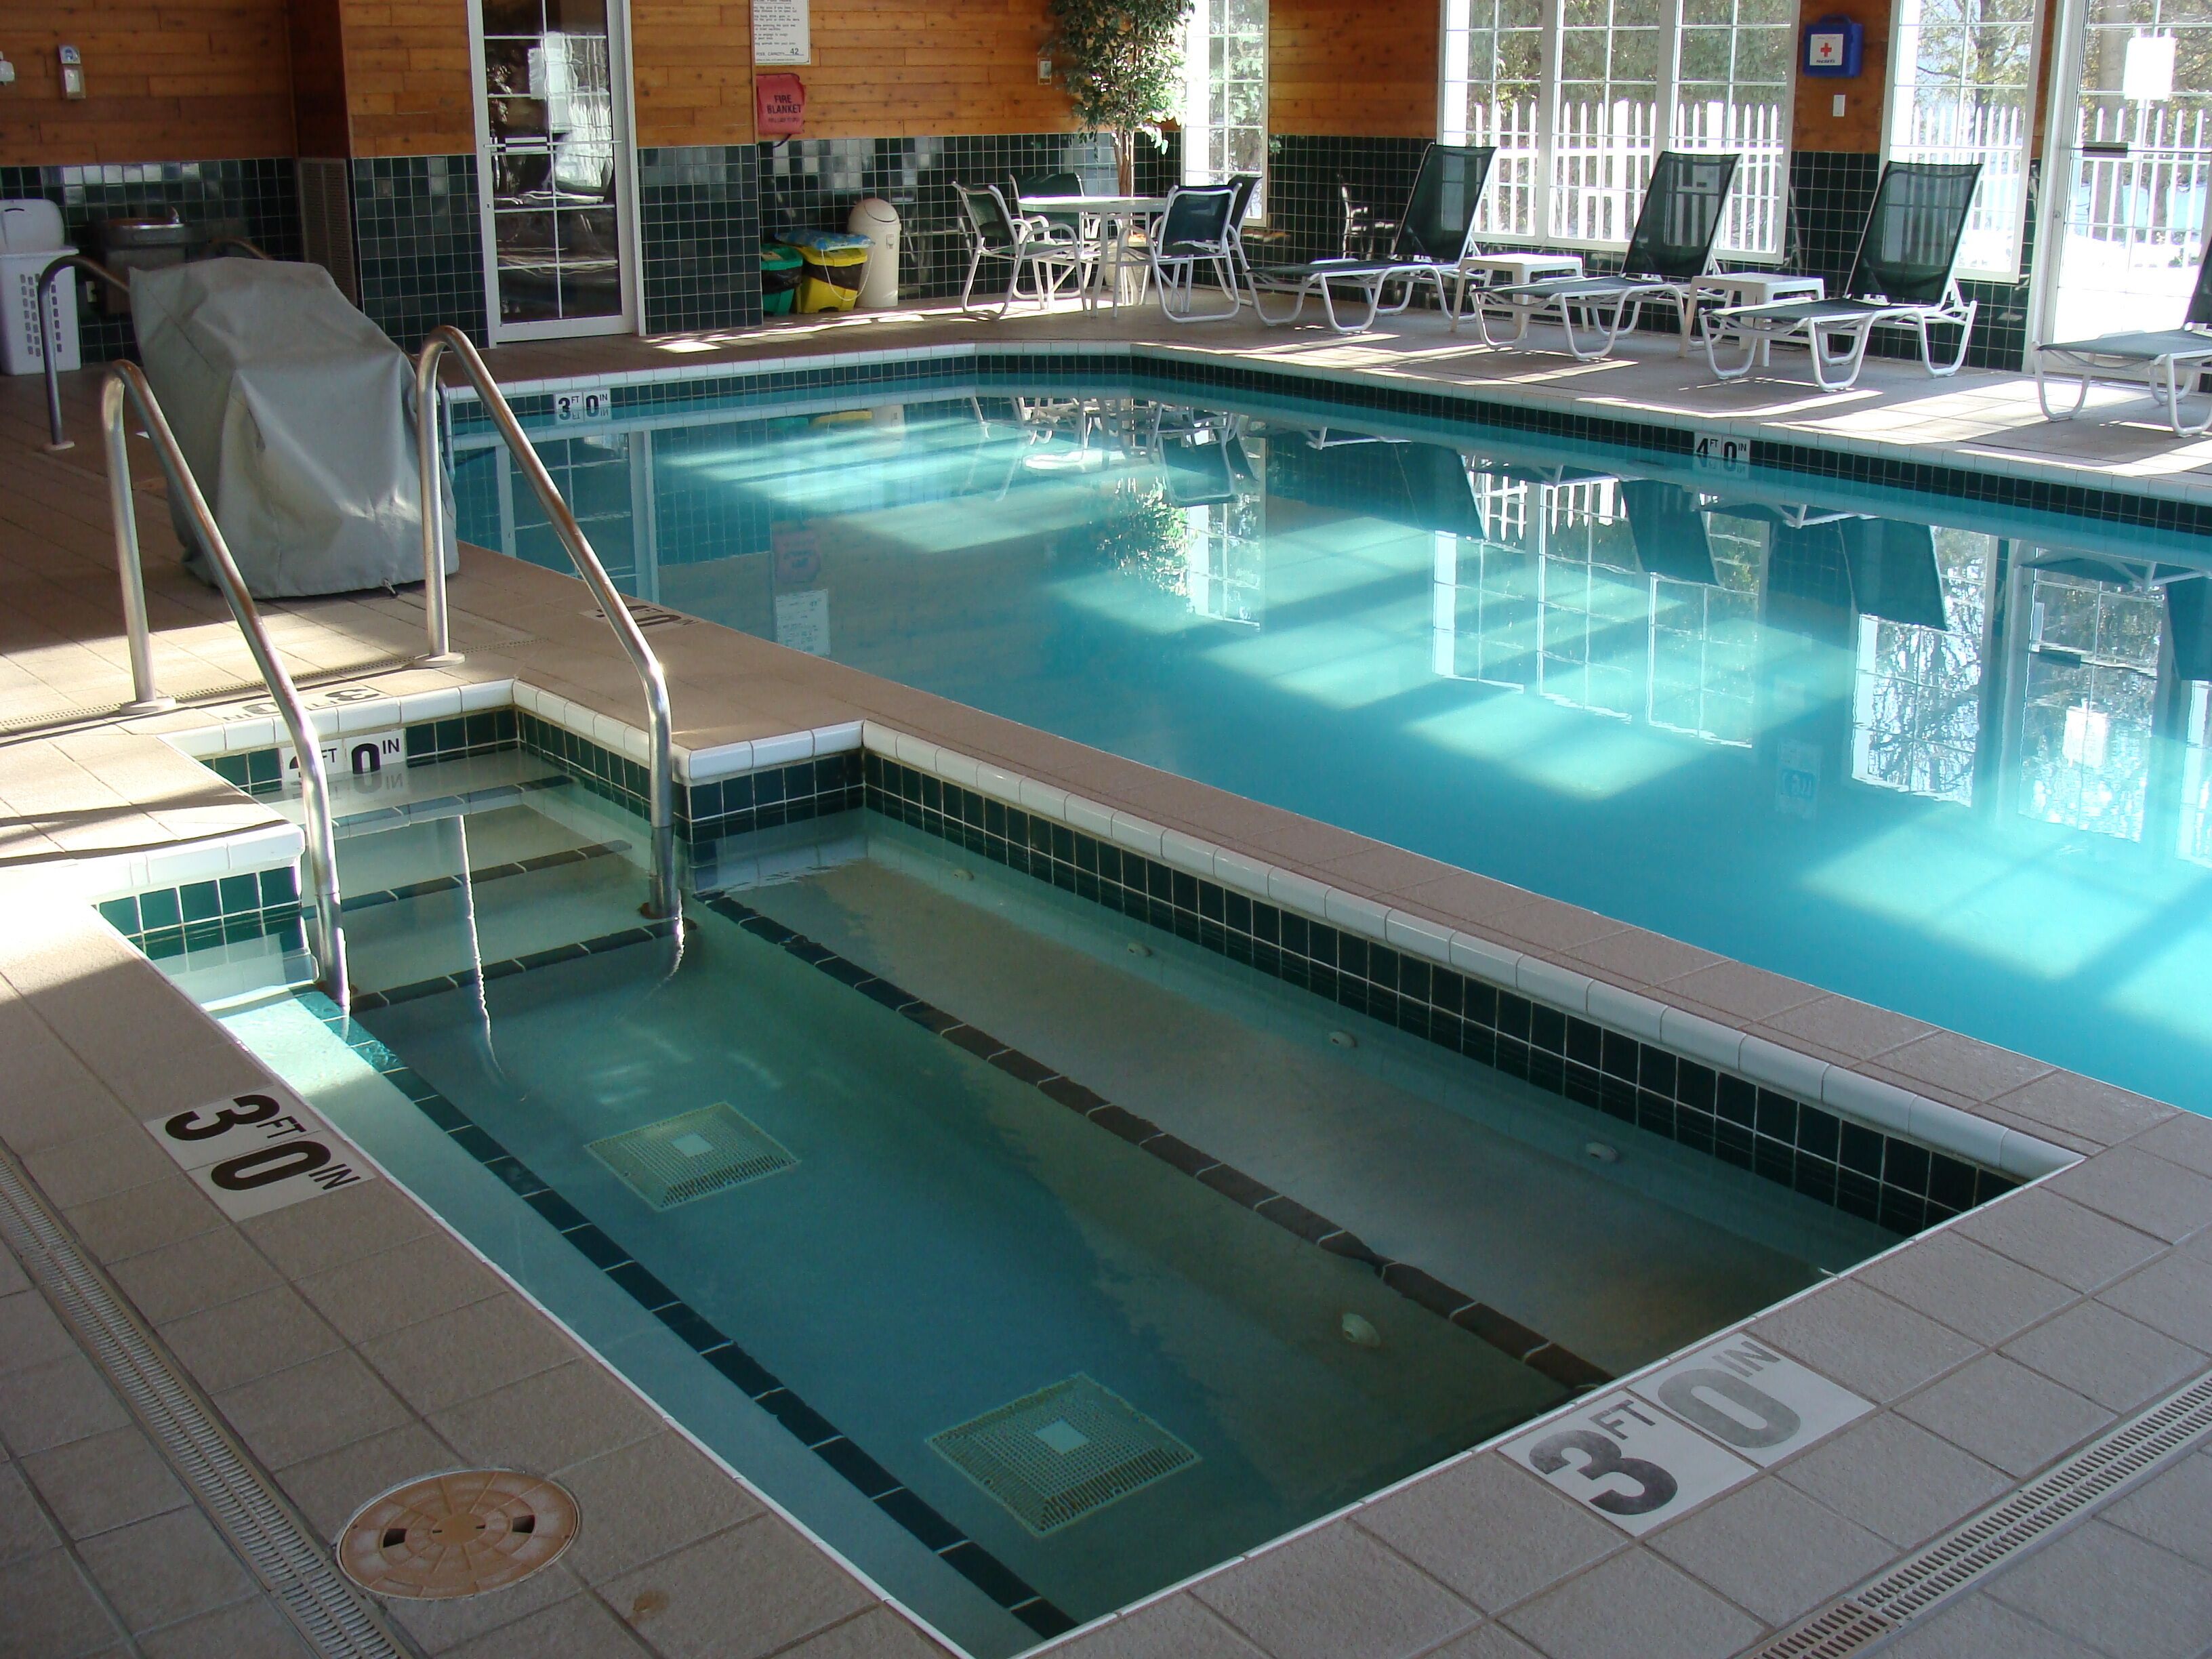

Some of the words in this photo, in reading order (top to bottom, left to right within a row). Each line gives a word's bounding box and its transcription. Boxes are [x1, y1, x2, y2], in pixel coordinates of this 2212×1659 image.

[766, 104, 801, 114] BLANKET
[774, 94, 792, 103] FIRE
[1696, 438, 1708, 455] 4
[1710, 439, 1719, 447] FT
[1724, 441, 1737, 461] 0
[1738, 443, 1746, 451] IN
[382, 738, 401, 754] IN
[165, 1094, 280, 1141] 3
[256, 1115, 307, 1139] FT
[211, 1141, 331, 1191] 0
[308, 1164, 361, 1190] IN
[1712, 1340, 1780, 1378] IN
[1589, 1399, 1656, 1440] FT
[1658, 1368, 1801, 1448] 0
[1528, 1429, 1678, 1515] 3
